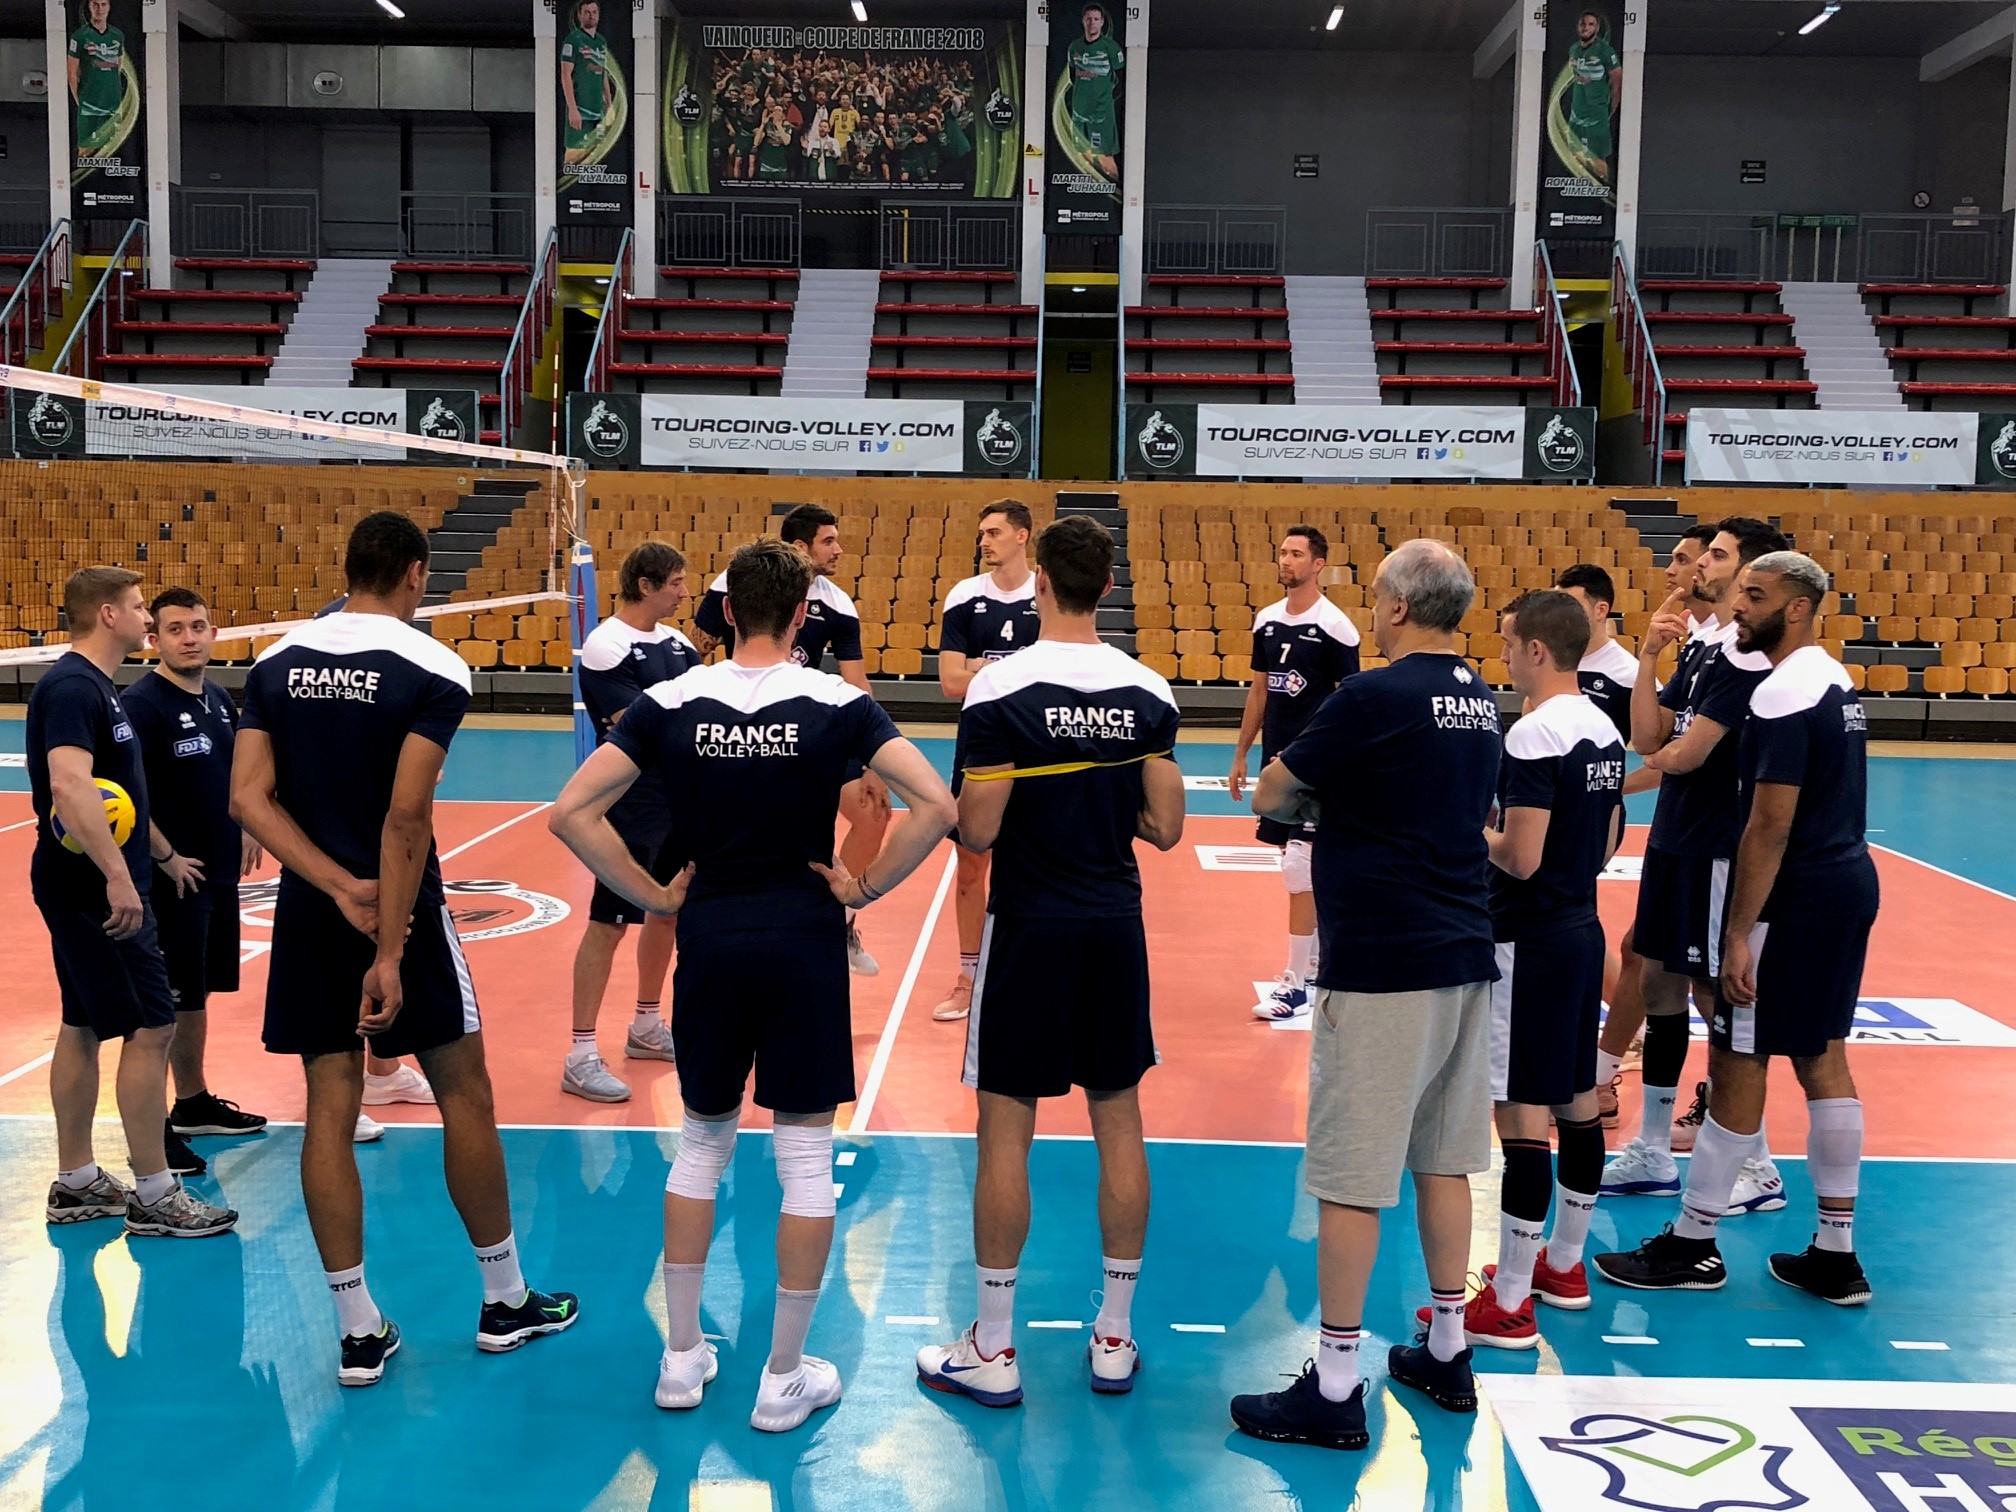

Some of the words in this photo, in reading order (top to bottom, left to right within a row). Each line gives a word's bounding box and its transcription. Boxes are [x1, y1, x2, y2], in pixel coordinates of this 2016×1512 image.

[702, 26, 795, 49] VAINQUEUR
[803, 27, 858, 49] COUPE
[858, 27, 881, 50] DE
[881, 28, 945, 50] FRANCE
[944, 28, 985, 50] 2018
[77, 157, 121, 168] MAXIME
[105, 166, 140, 177] CAPET
[563, 165, 607, 175] OLEKSIY
[578, 173, 627, 184] KLYAMAR
[639, 171, 650, 188] L
[1545, 177, 1590, 188] RONALD
[1028, 178, 1039, 195] L
[1067, 183, 1116, 194] JUHKAMI
[1560, 186, 1610, 197] JIMENEZ
[255, 428, 292, 440] SUR
[437, 428, 457, 437] TLM
[651, 417, 954, 437] TOURCOING-VOLLEY.COM
[600, 432, 621, 440] TLM
[1207, 427, 1515, 444] TOURCOING-VOLLEY.COM
[1708, 434, 1958, 449] TOURCOING-VOLLEY.COM
[689, 437, 807, 451] SUIVEZ-NOUS
[812, 440, 849, 452] SUR
[993, 440, 1014, 449] TLM
[1156, 442, 1176, 451] TLM
[1555, 446, 1576, 455] TLM
[1244, 447, 1364, 460] SUIVEZ-NOUS
[1369, 448, 1407, 460] SUR
[1743, 449, 1840, 461] SUIVEZ-NOUS
[1845, 450, 1875, 462] SUR
[1000, 620, 1014, 641] 4
[1279, 643, 1292, 664] 7
[287, 668, 381, 691] FRANCE
[1268, 675, 1283, 687] DJ
[287, 686, 376, 704] VOLLEY-BALL
[1431, 696, 1498, 722] FRANCE
[1044, 706, 1136, 728] FRANCE
[695, 723, 799, 745] FRANCE
[1047, 725, 1136, 741] VOLLEY-BALL
[177, 741, 201, 755] FDJ
[695, 743, 799, 758] VOLLEY-BALL
